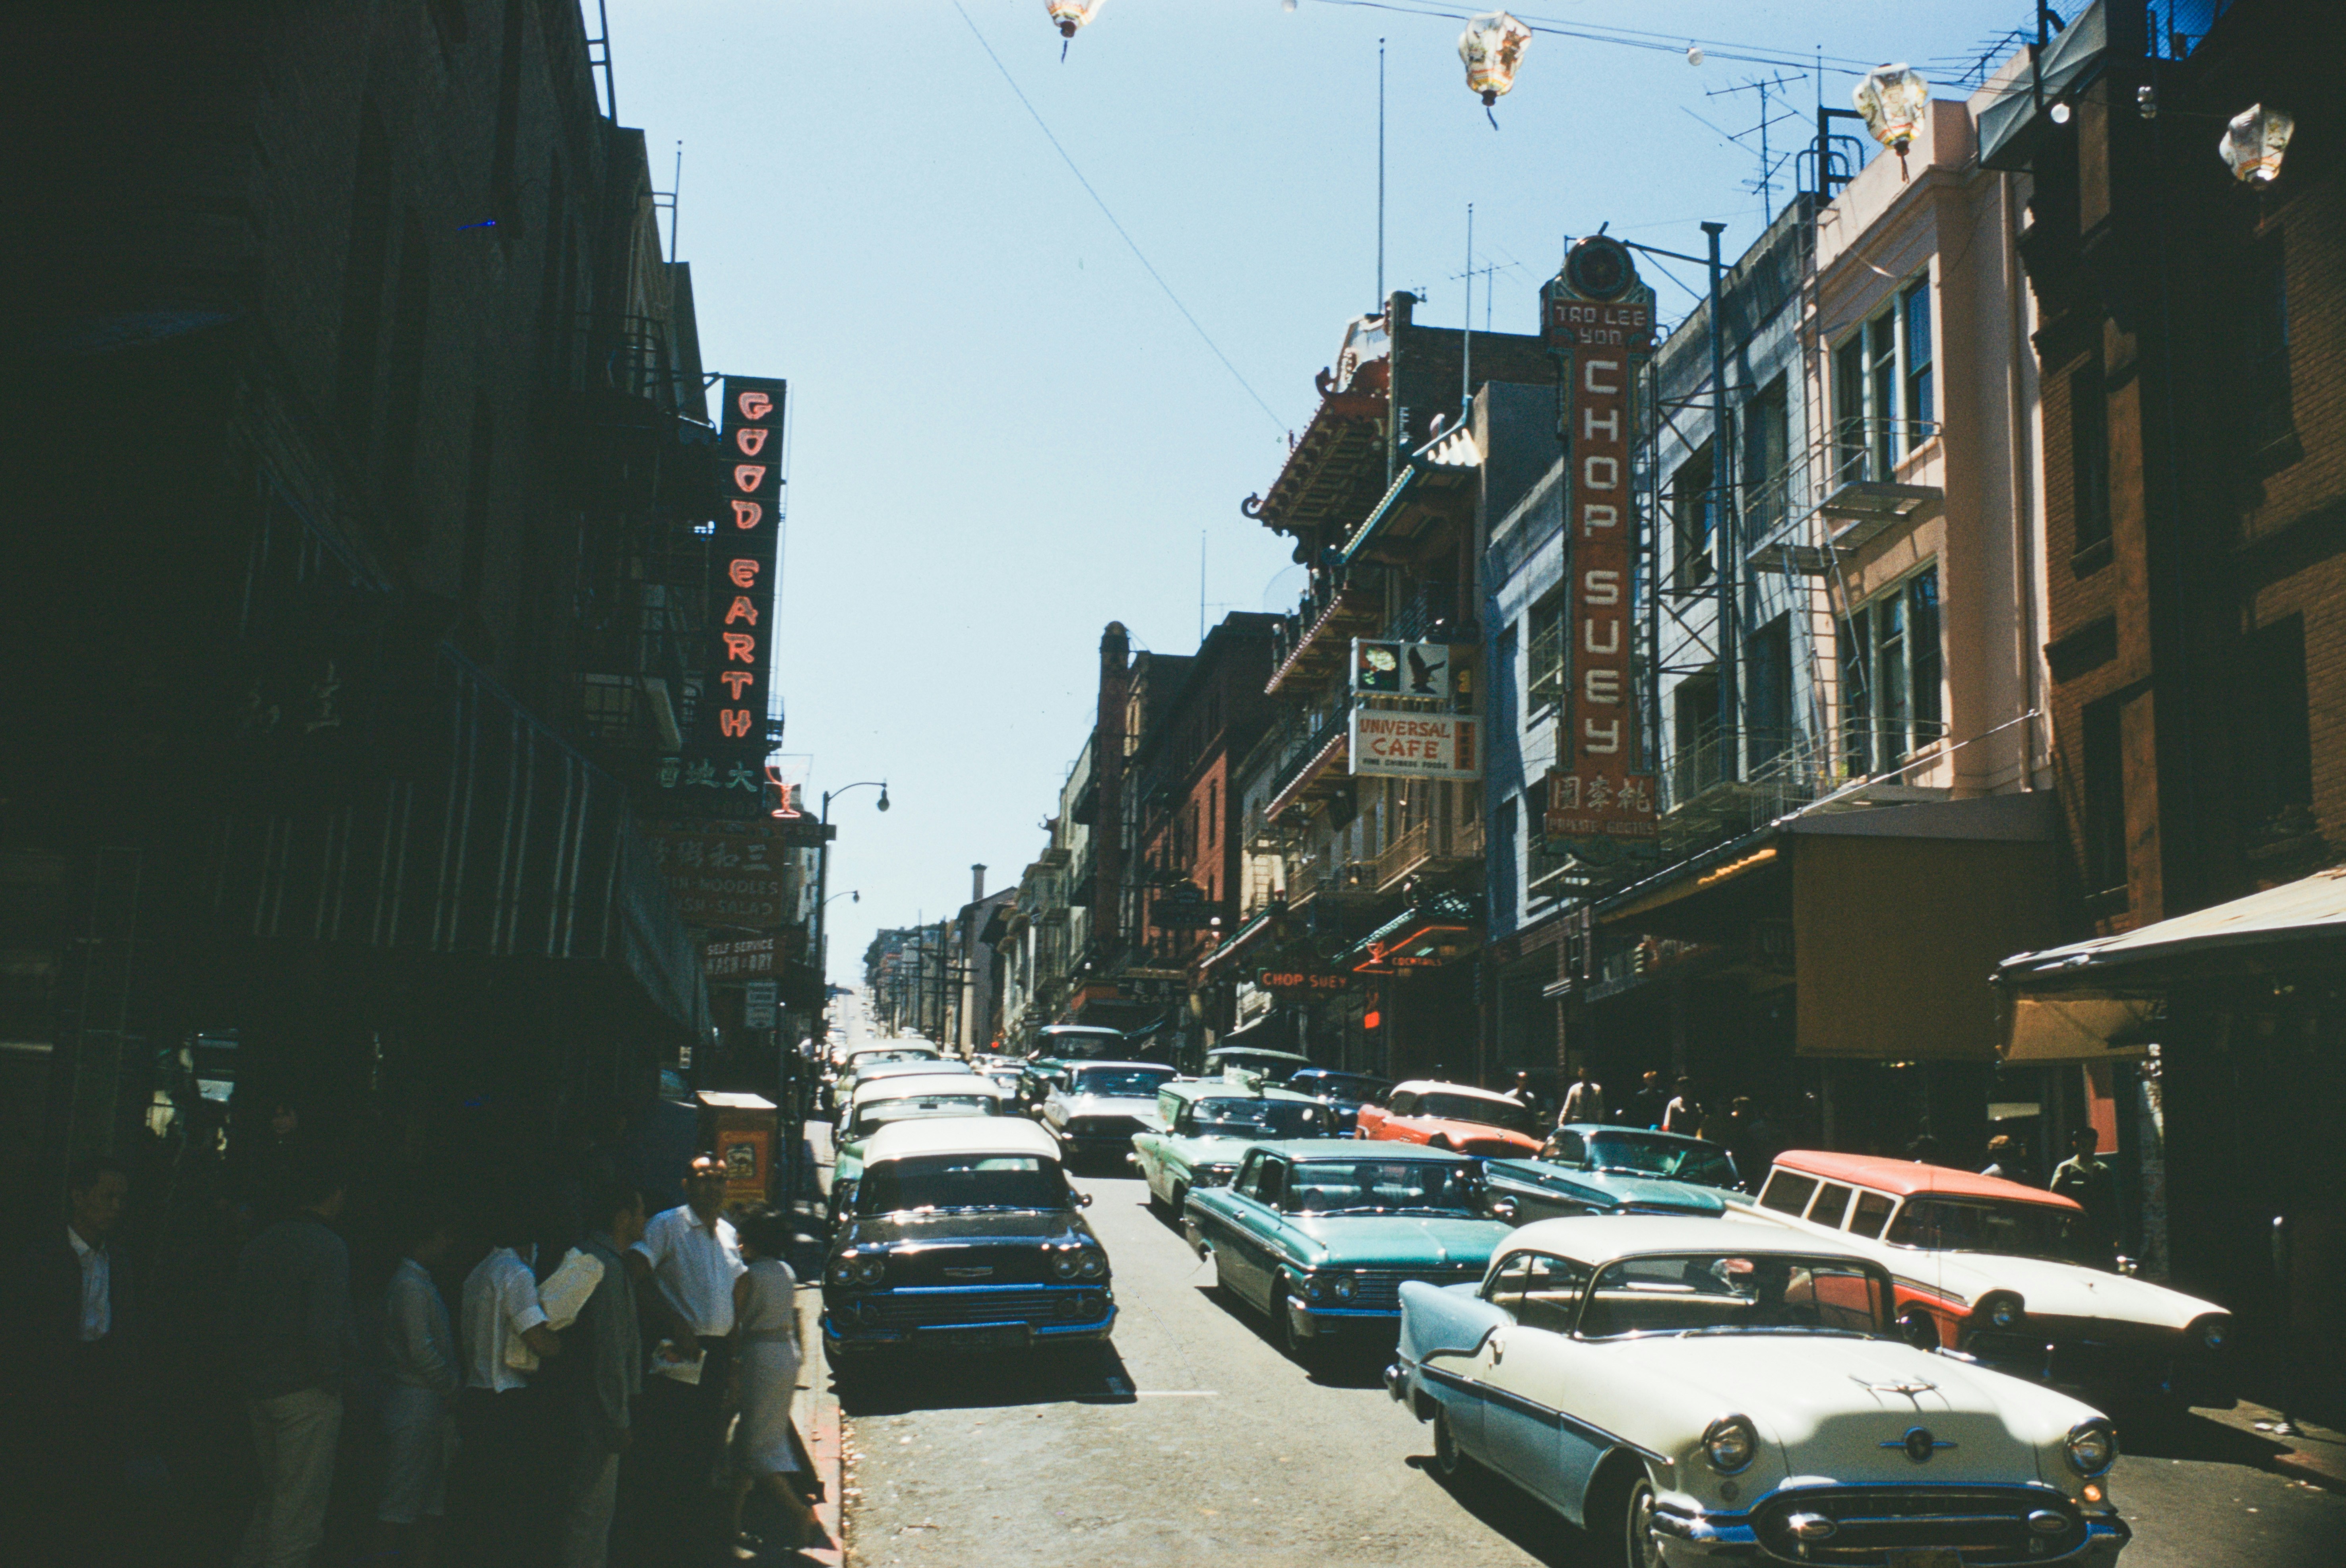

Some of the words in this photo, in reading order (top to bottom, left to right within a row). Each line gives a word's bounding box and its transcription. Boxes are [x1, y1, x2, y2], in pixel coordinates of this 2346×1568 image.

[1605, 310, 1645, 326] LEE
[731, 392, 773, 529] GOOD
[1584, 360, 1619, 537] CHOP
[720, 558, 760, 737] EARTH
[1584, 570, 1619, 754] SUEY
[1360, 719, 1451, 738] UNIVERSAL
[1371, 737, 1439, 759] CAFE
[1262, 972, 1304, 986] CHOP
[1309, 975, 1347, 989] SUEY
